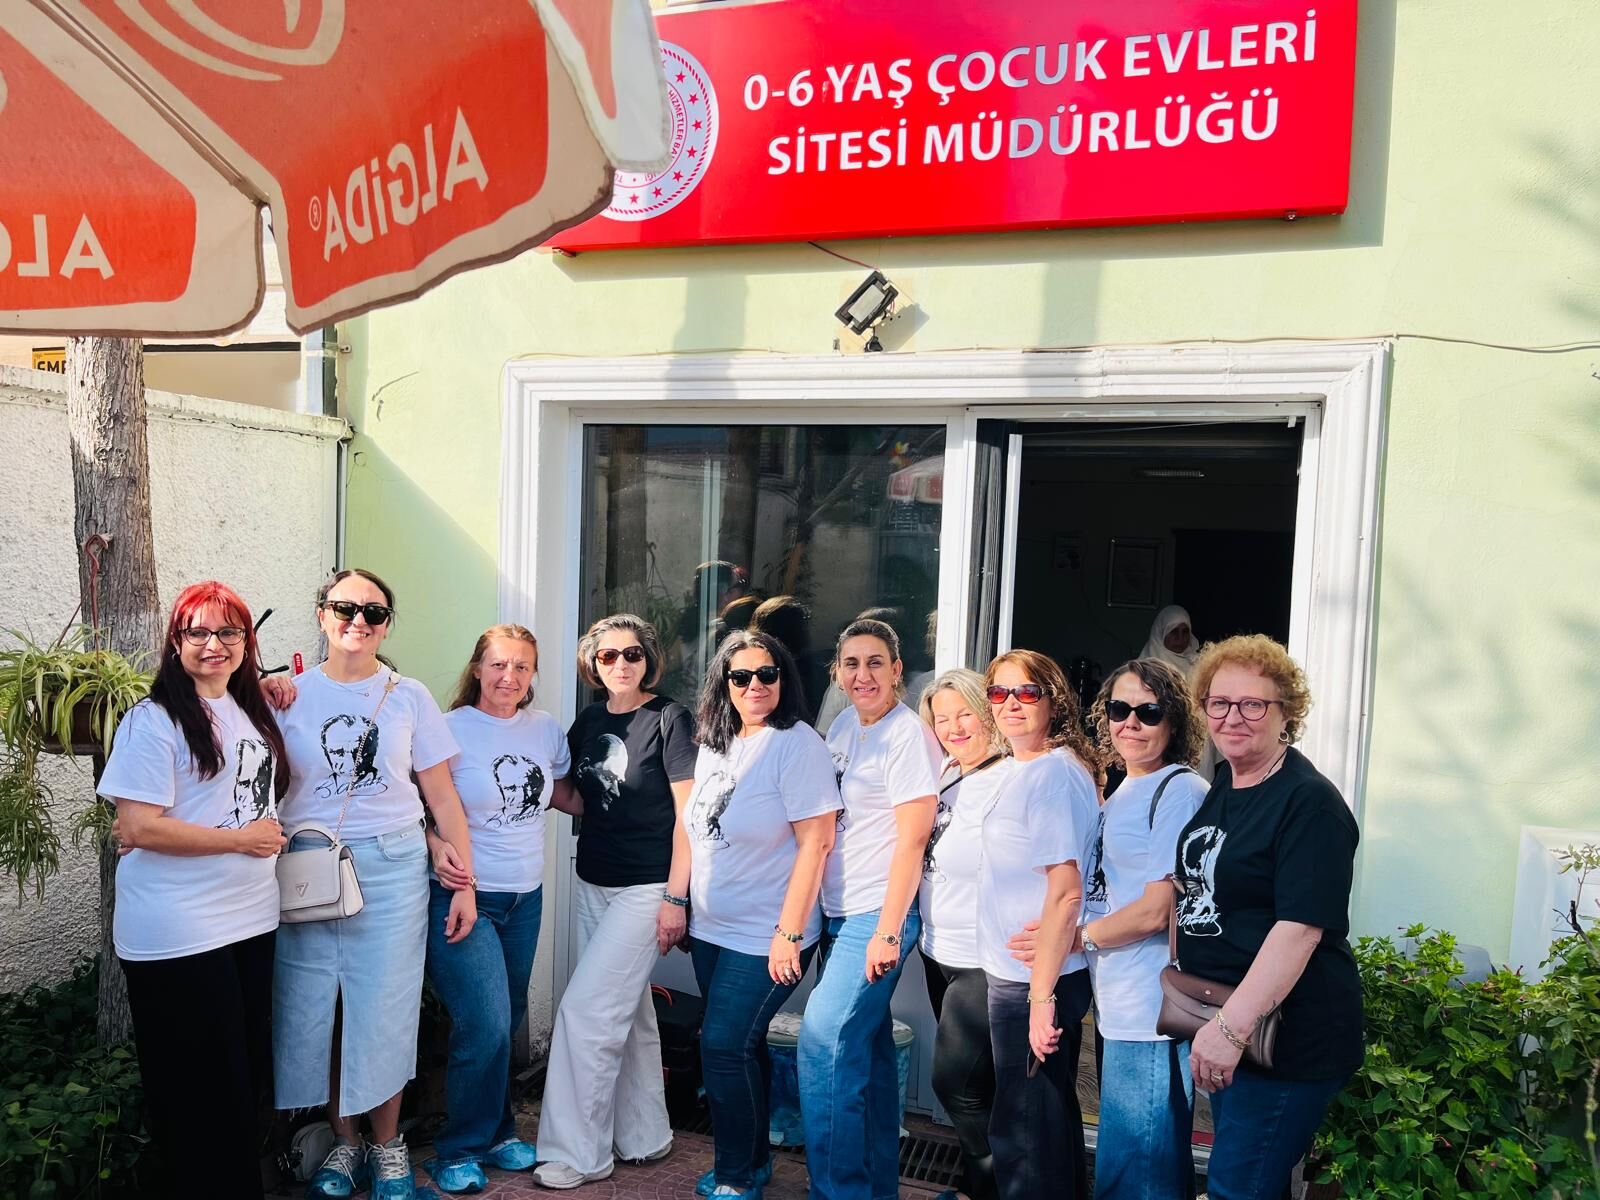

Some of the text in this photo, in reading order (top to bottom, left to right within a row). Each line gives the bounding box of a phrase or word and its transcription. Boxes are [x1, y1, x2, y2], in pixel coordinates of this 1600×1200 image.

[743, 8, 1317, 111] 0-6 YAŞ ÇOCUK EVLERİ
[767, 87, 1279, 176] SİTESİ MÜDÜRLÜĞÜ
